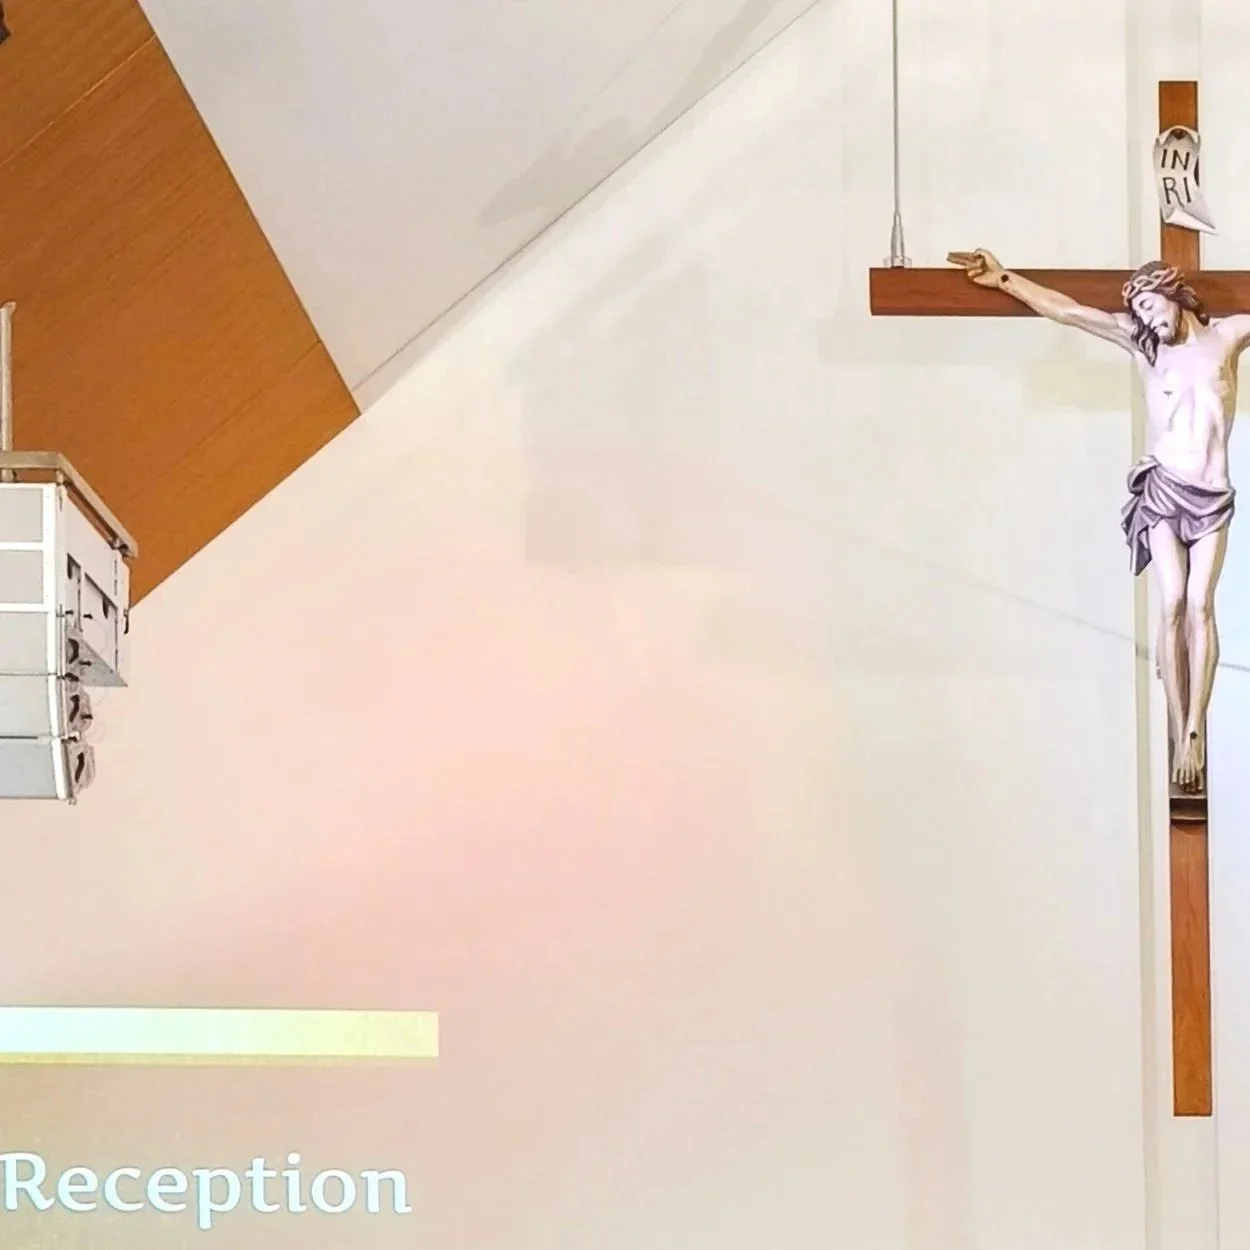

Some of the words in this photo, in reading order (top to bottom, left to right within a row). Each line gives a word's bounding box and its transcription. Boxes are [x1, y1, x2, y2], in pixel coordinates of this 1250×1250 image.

[1161, 148, 1190, 170] IN
[1162, 176, 1191, 208] RI
[0, 1152, 413, 1230] Reception
